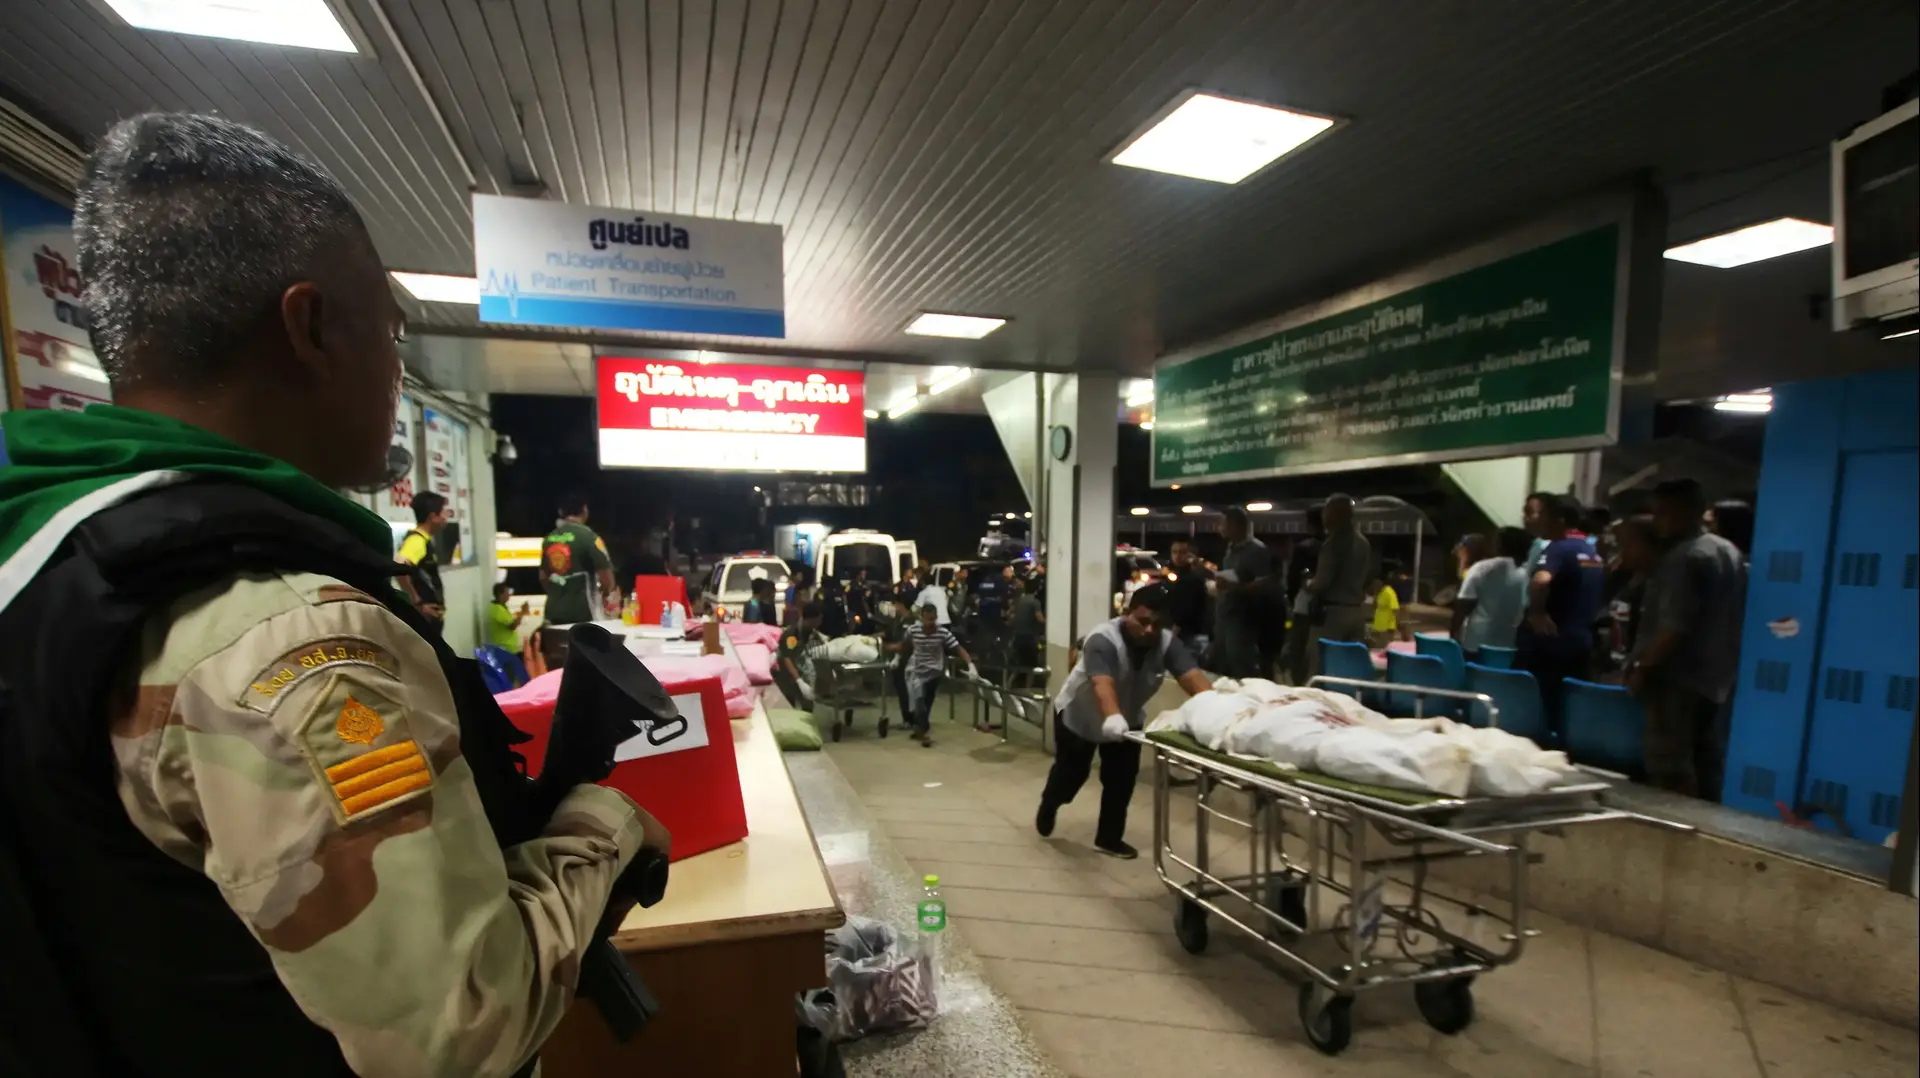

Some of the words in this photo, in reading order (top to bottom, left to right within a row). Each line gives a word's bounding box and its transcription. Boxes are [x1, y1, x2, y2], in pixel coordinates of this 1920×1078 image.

[589, 216, 690, 250] ศูนย์เปล
[532, 272, 597, 292] Patient
[609, 277, 736, 301] Transportation
[650, 407, 820, 433] EMERGENCY
